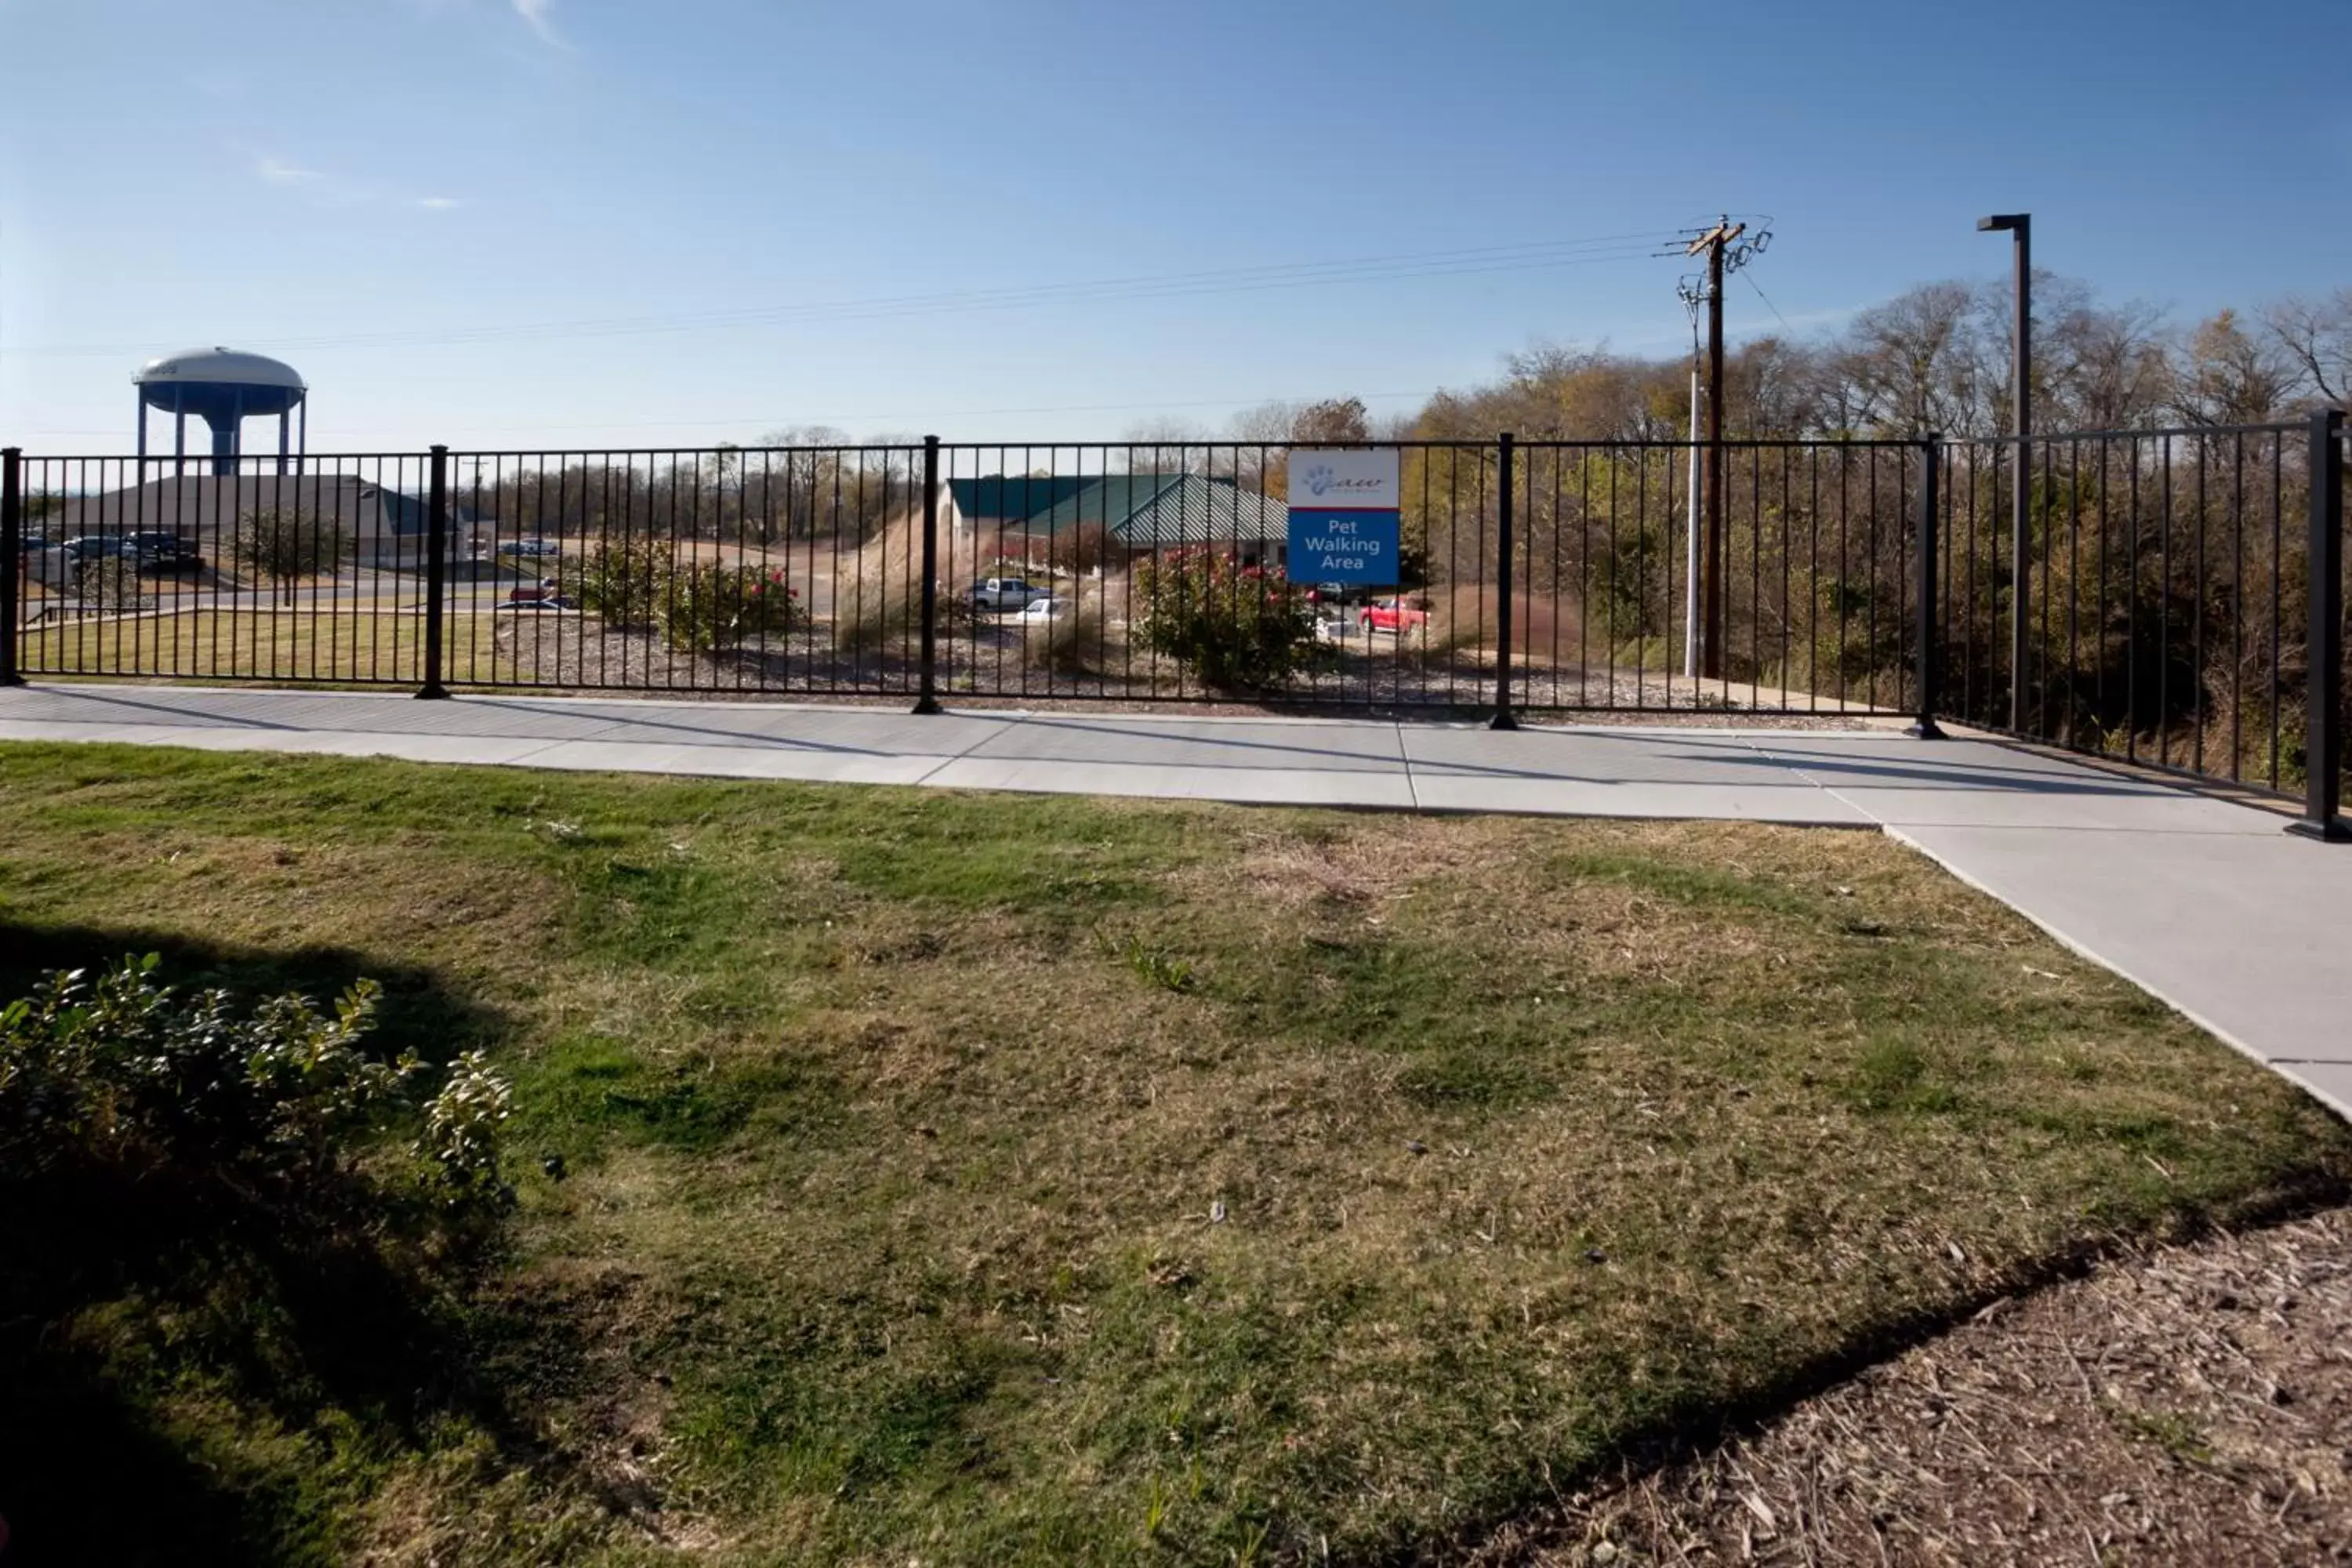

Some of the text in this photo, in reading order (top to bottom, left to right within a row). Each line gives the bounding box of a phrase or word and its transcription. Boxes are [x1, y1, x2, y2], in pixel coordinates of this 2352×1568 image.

[1329, 520, 1358, 534] Pet
[1305, 537, 1380, 555] Walking
[1321, 555, 1364, 569] Area
